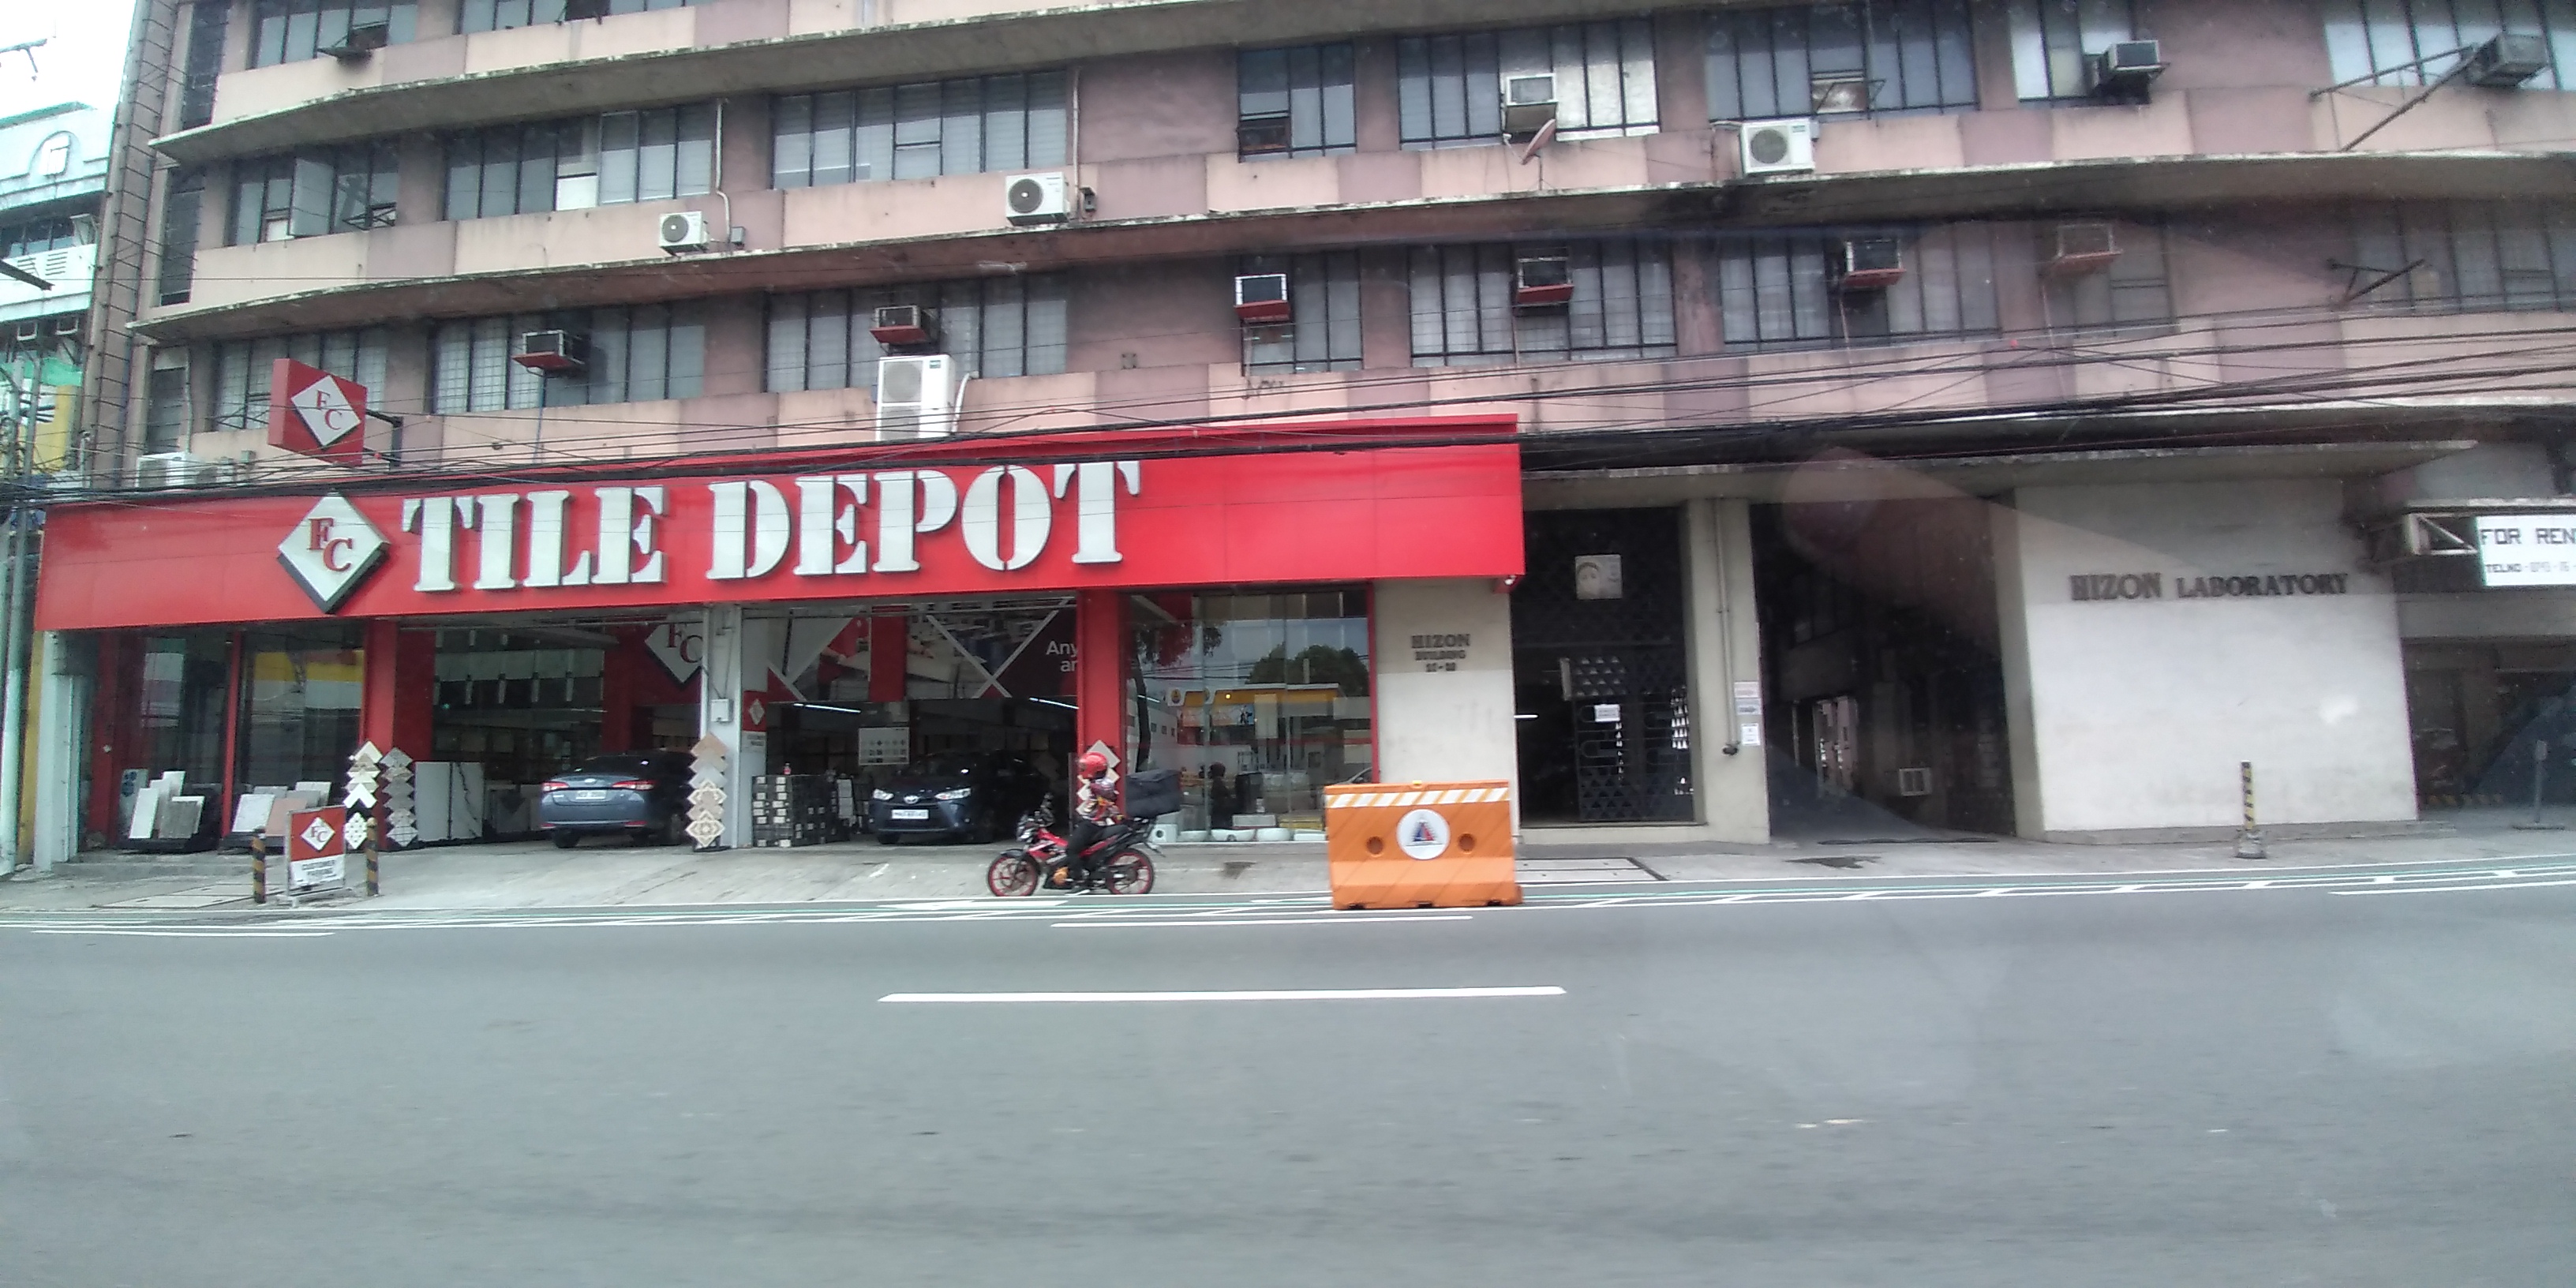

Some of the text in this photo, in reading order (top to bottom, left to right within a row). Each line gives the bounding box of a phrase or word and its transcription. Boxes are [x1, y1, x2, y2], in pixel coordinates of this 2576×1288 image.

[316, 389, 343, 430] FC
[402, 460, 1140, 592] TILE DEPOT
[2480, 527, 2522, 545] FOR
[306, 517, 353, 572] FC
[2069, 572, 2348, 601] HIZON LABORATORY
[1411, 634, 1471, 649] HIZON
